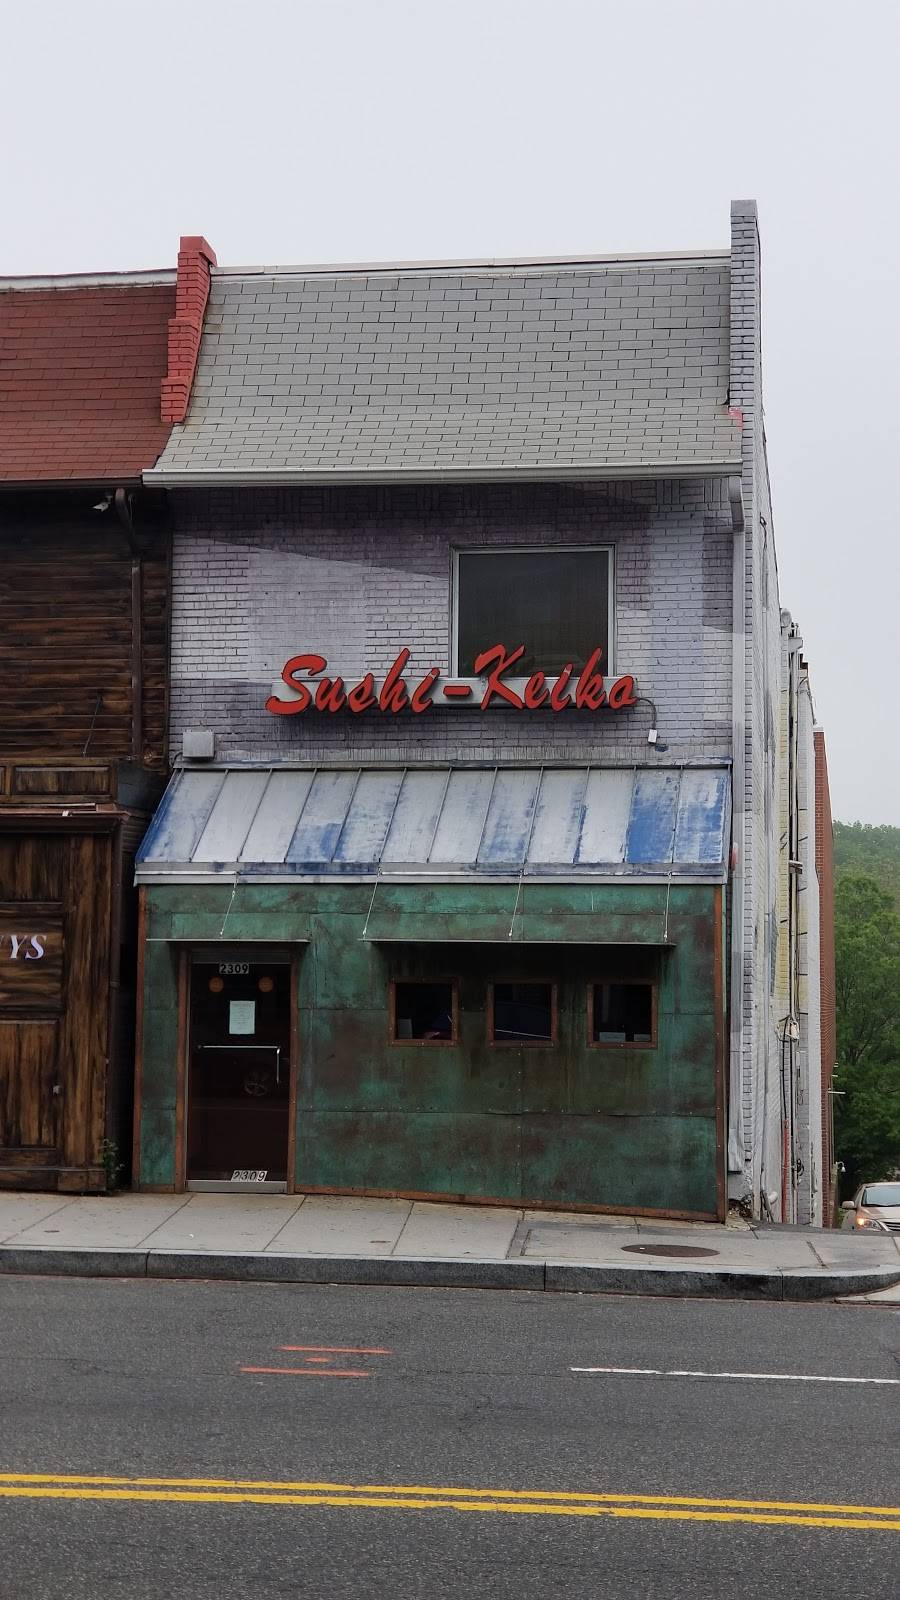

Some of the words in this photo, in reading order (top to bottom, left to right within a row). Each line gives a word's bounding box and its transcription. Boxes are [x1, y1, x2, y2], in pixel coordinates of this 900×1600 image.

[265, 644, 637, 715] Sushi-Keiko
[0, 934, 48, 960] YS
[219, 964, 249, 974] 2309
[232, 1170, 267, 1182] 2309
